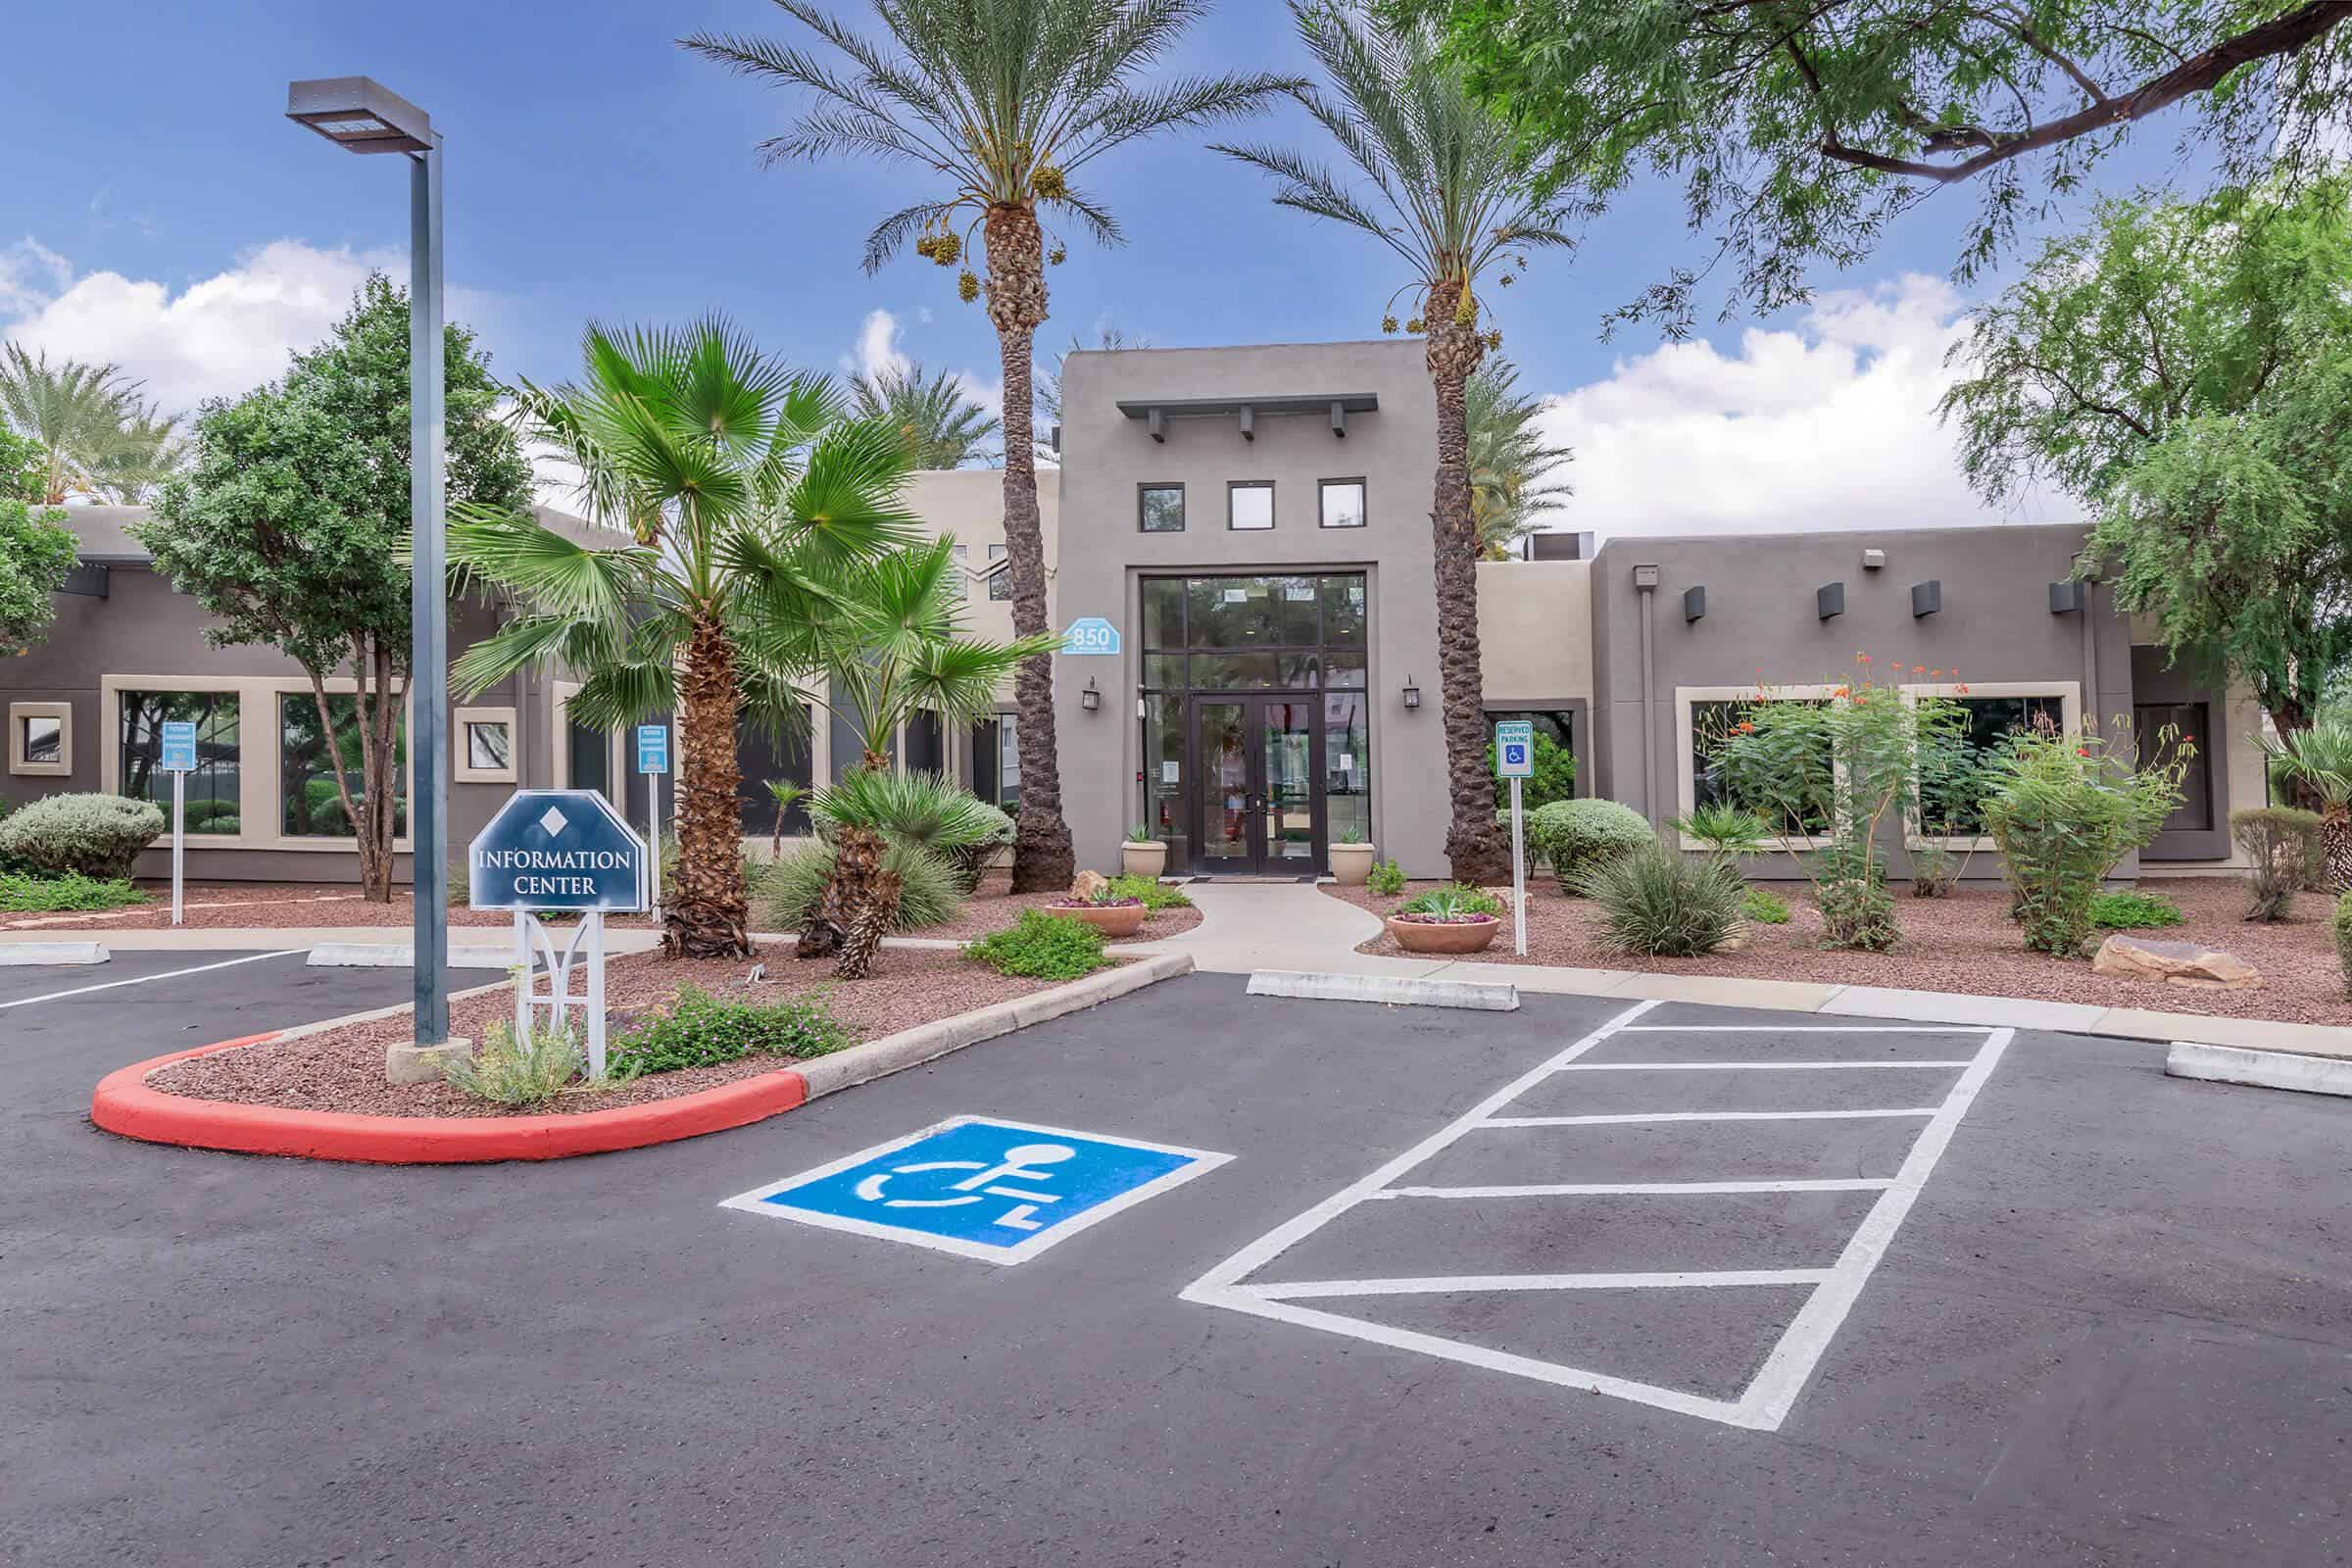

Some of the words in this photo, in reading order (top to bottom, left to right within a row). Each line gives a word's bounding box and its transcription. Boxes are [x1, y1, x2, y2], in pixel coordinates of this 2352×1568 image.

[1074, 628, 1109, 646] 850
[477, 850, 631, 869] INFORMATION
[514, 876, 597, 895] CENTER
